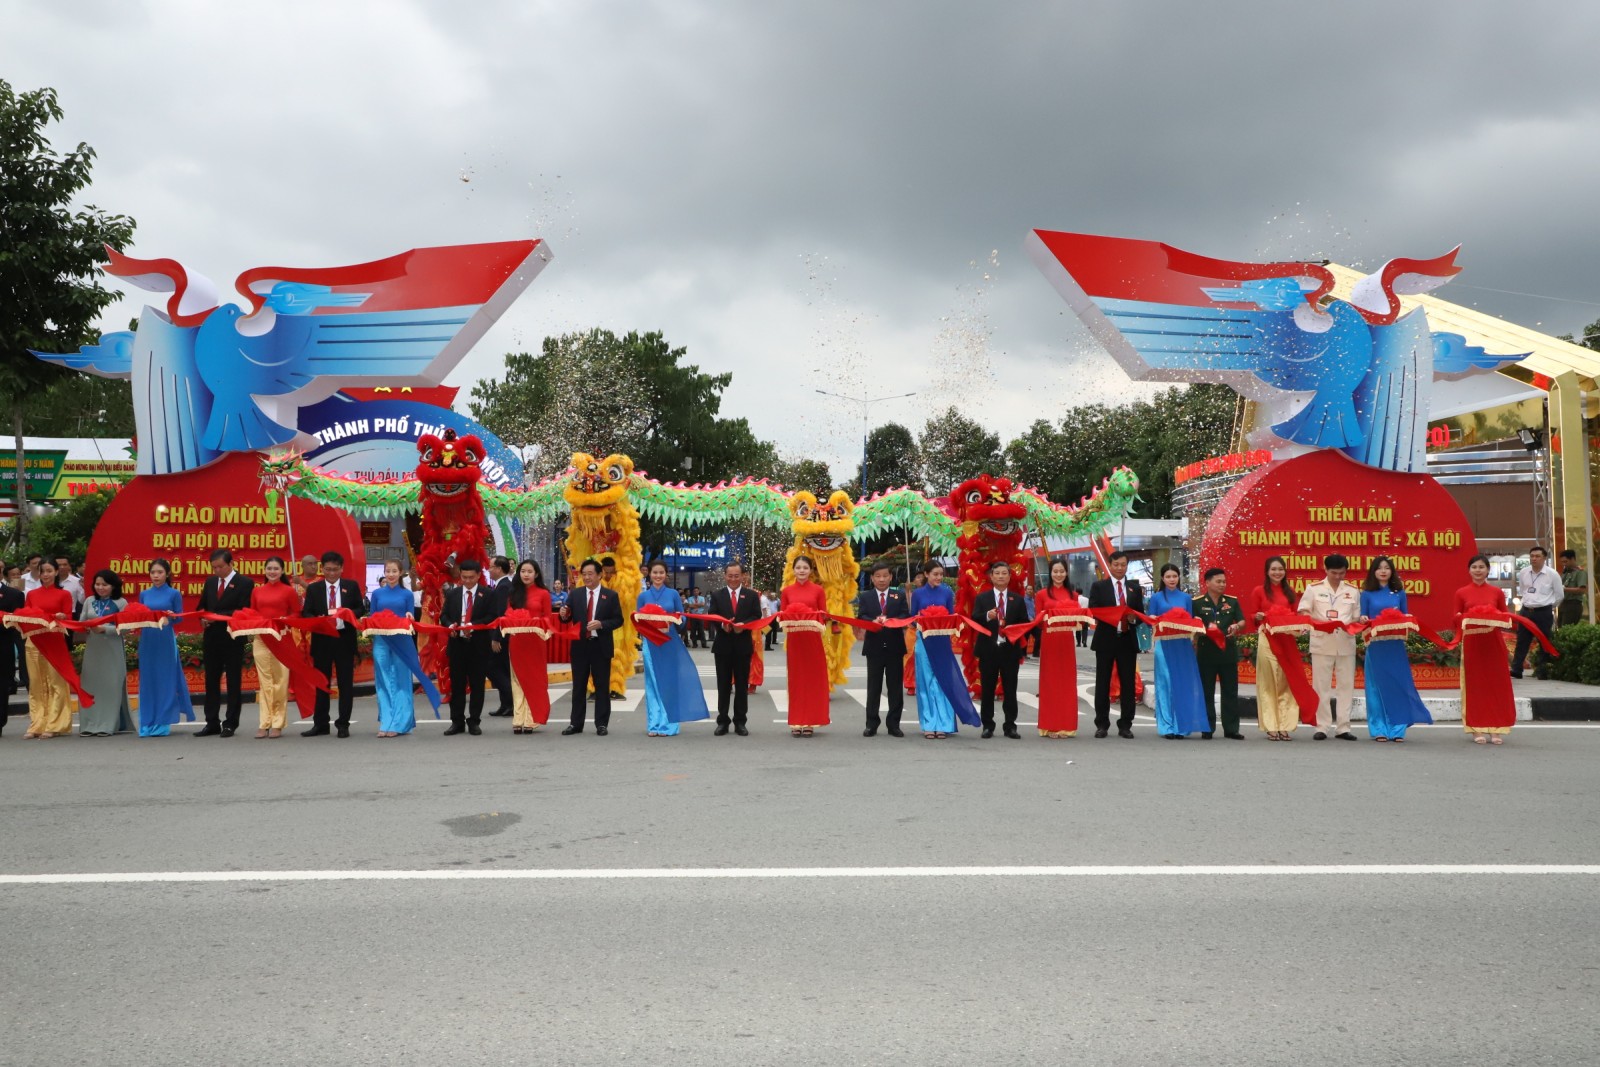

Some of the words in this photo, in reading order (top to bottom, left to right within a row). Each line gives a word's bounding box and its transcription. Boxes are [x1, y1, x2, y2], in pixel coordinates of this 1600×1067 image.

[312, 418, 369, 446] THÀNH
[374, 414, 411, 434] PHỐ
[479, 456, 510, 487] MỘT
[155, 503, 214, 524] CHÀO
[220, 503, 286, 524] MỪNG
[1308, 501, 1354, 522] TRIỂN
[1358, 503, 1393, 522] LÃM
[152, 533, 180, 551] ĐẠI
[186, 530, 212, 551] HỘI
[217, 533, 244, 552] ĐẠI
[249, 528, 286, 549] BIỂU
[1238, 527, 1290, 546] THÀNH
[1295, 529, 1325, 550] TỰU
[1329, 530, 1368, 546] KINH
[1372, 525, 1391, 546] TẾ
[1407, 528, 1428, 546] XÃ
[1433, 528, 1461, 551] HỘI
[186, 555, 215, 575] TỈN
[1280, 550, 1316, 570] TỈNH
